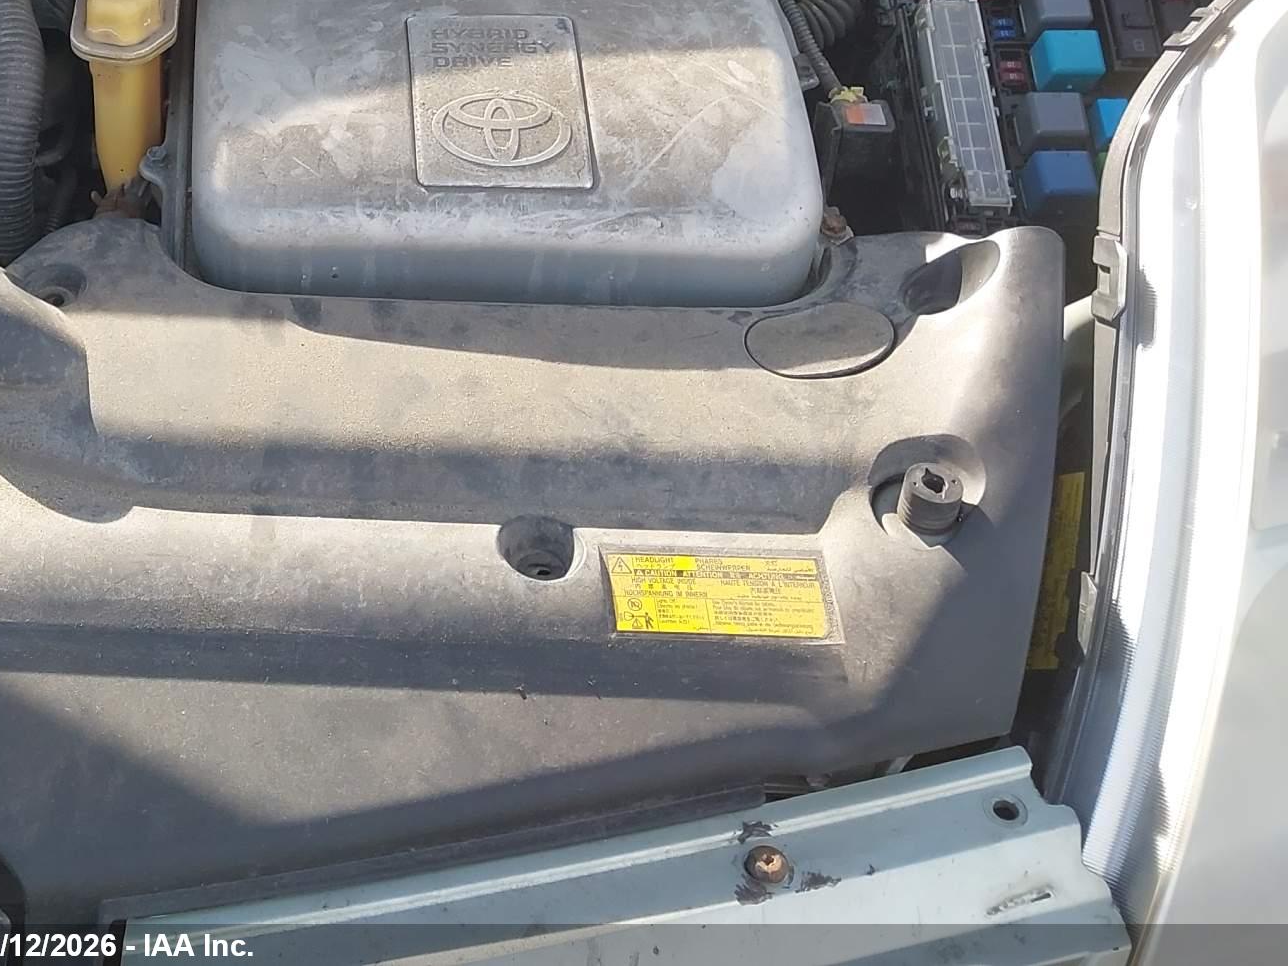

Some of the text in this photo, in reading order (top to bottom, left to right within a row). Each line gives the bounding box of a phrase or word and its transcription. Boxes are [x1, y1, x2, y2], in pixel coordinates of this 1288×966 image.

[431, 28, 529, 40] HYBRID
[431, 41, 556, 54] SYNERGY
[432, 56, 513, 68] DRIVE
[635, 556, 675, 564] HEADLIGHT
[645, 569, 677, 578] CAUTION
